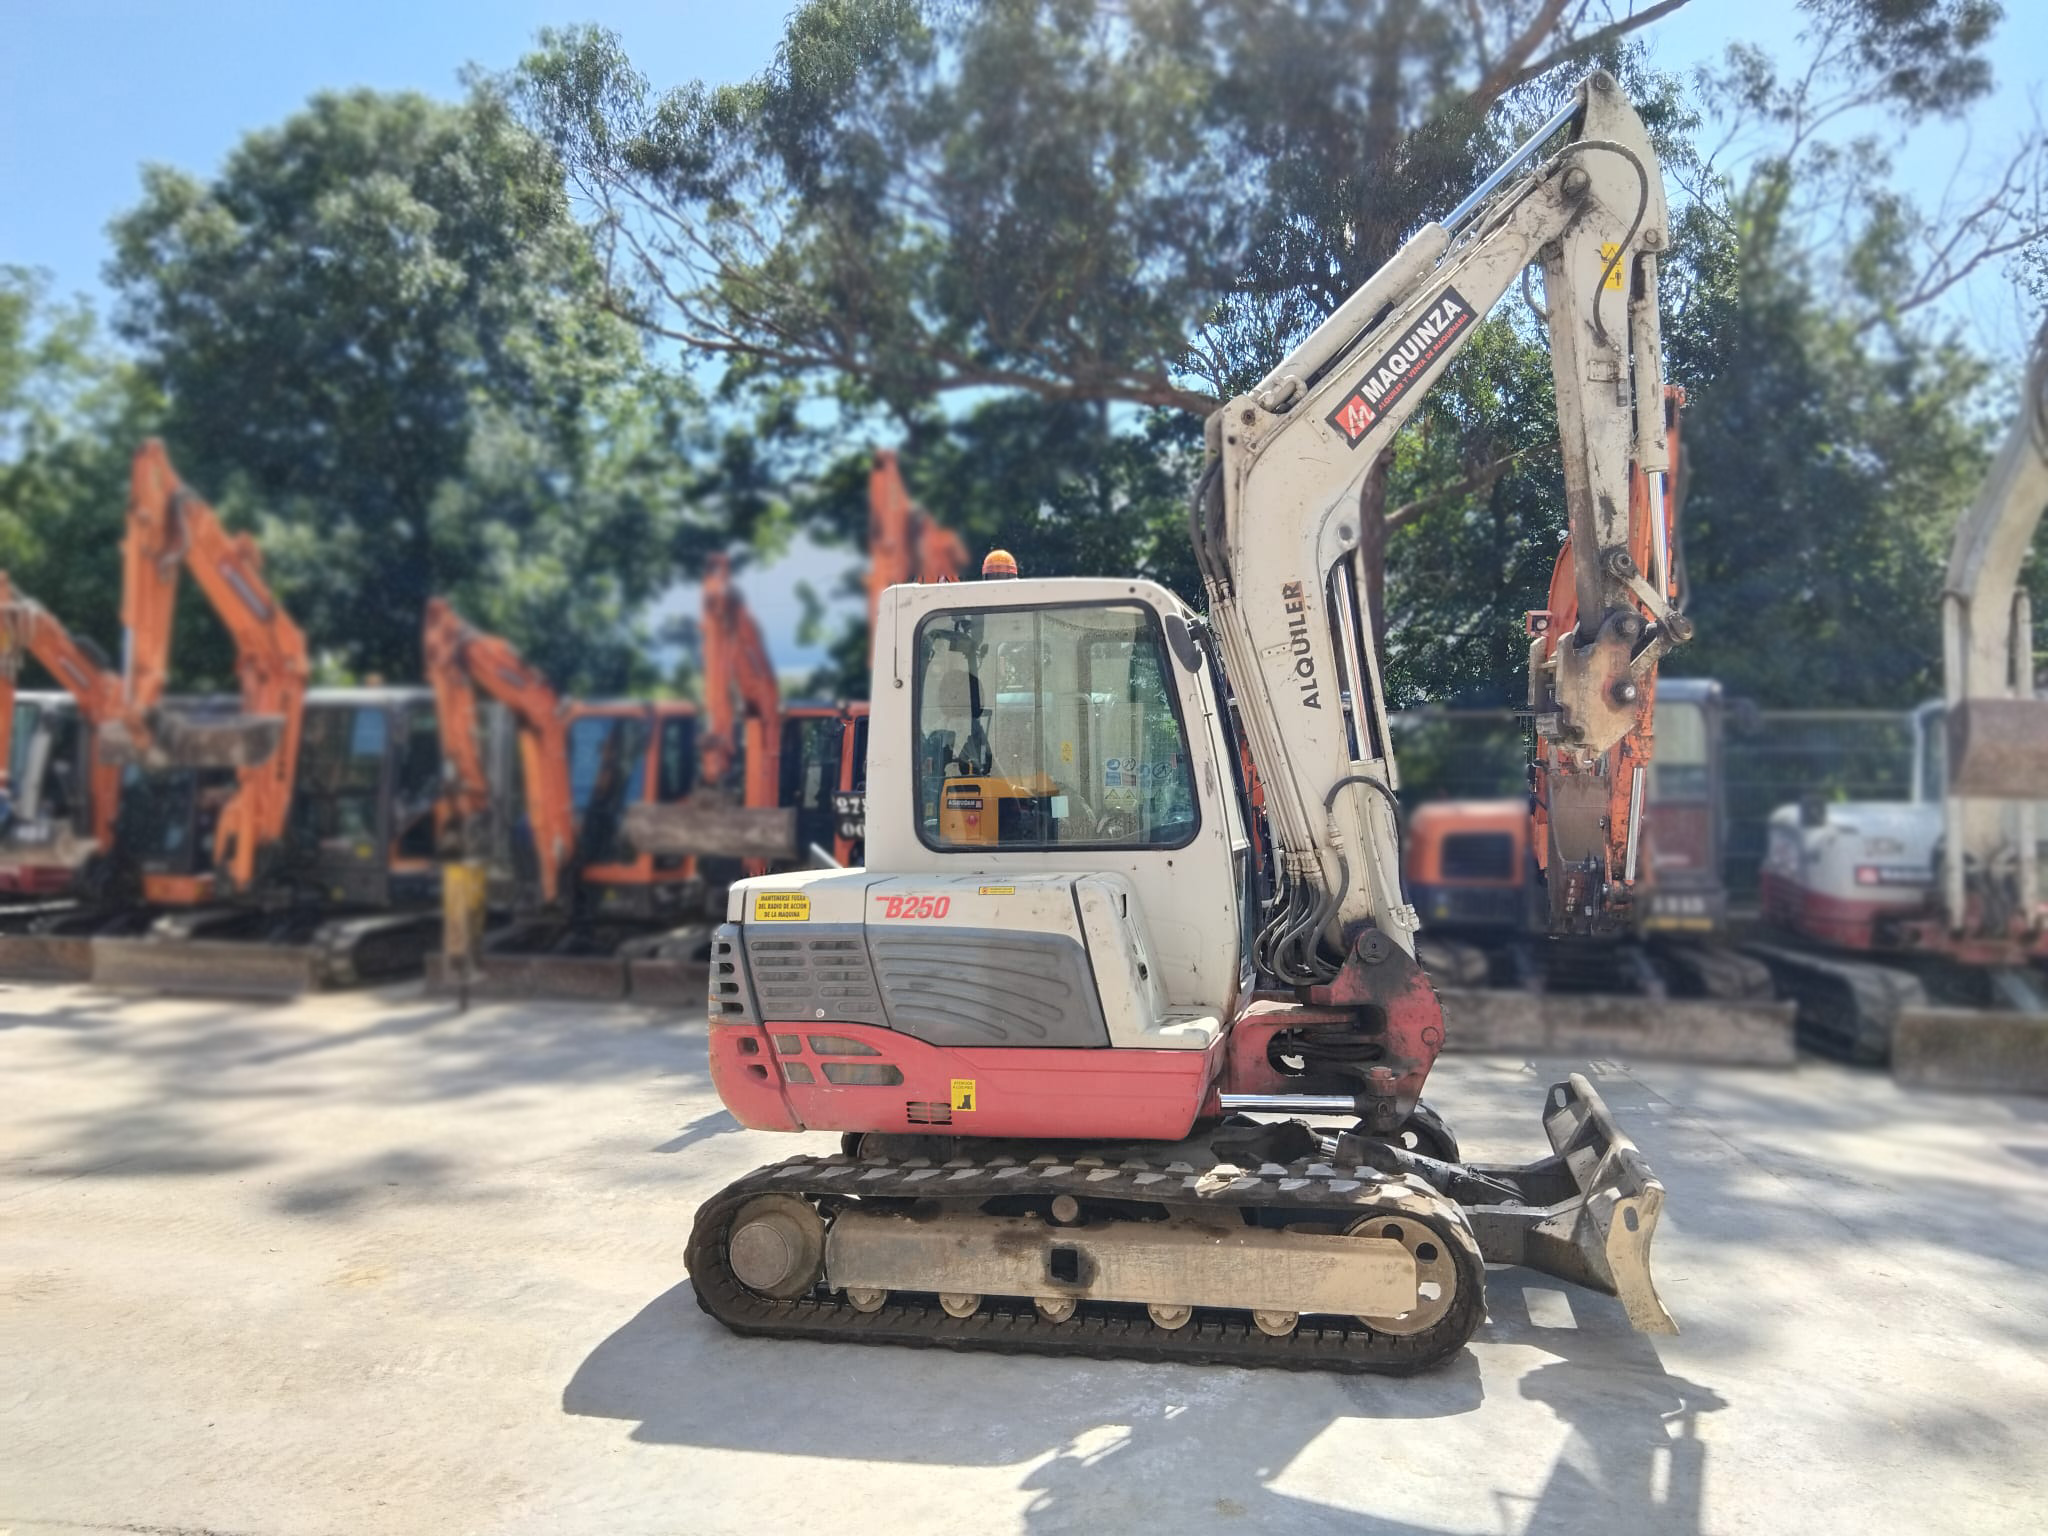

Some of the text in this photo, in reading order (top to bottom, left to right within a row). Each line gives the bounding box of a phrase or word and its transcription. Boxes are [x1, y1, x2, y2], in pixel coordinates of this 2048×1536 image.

[1361, 298, 1462, 404] MAQUINZA
[1378, 383, 1404, 412] ALQUILER
[1402, 376, 1409, 384] Y
[1408, 358, 1427, 378] VENTA
[1425, 350, 1434, 361] DE
[1282, 581, 1322, 710] ALQUILER
